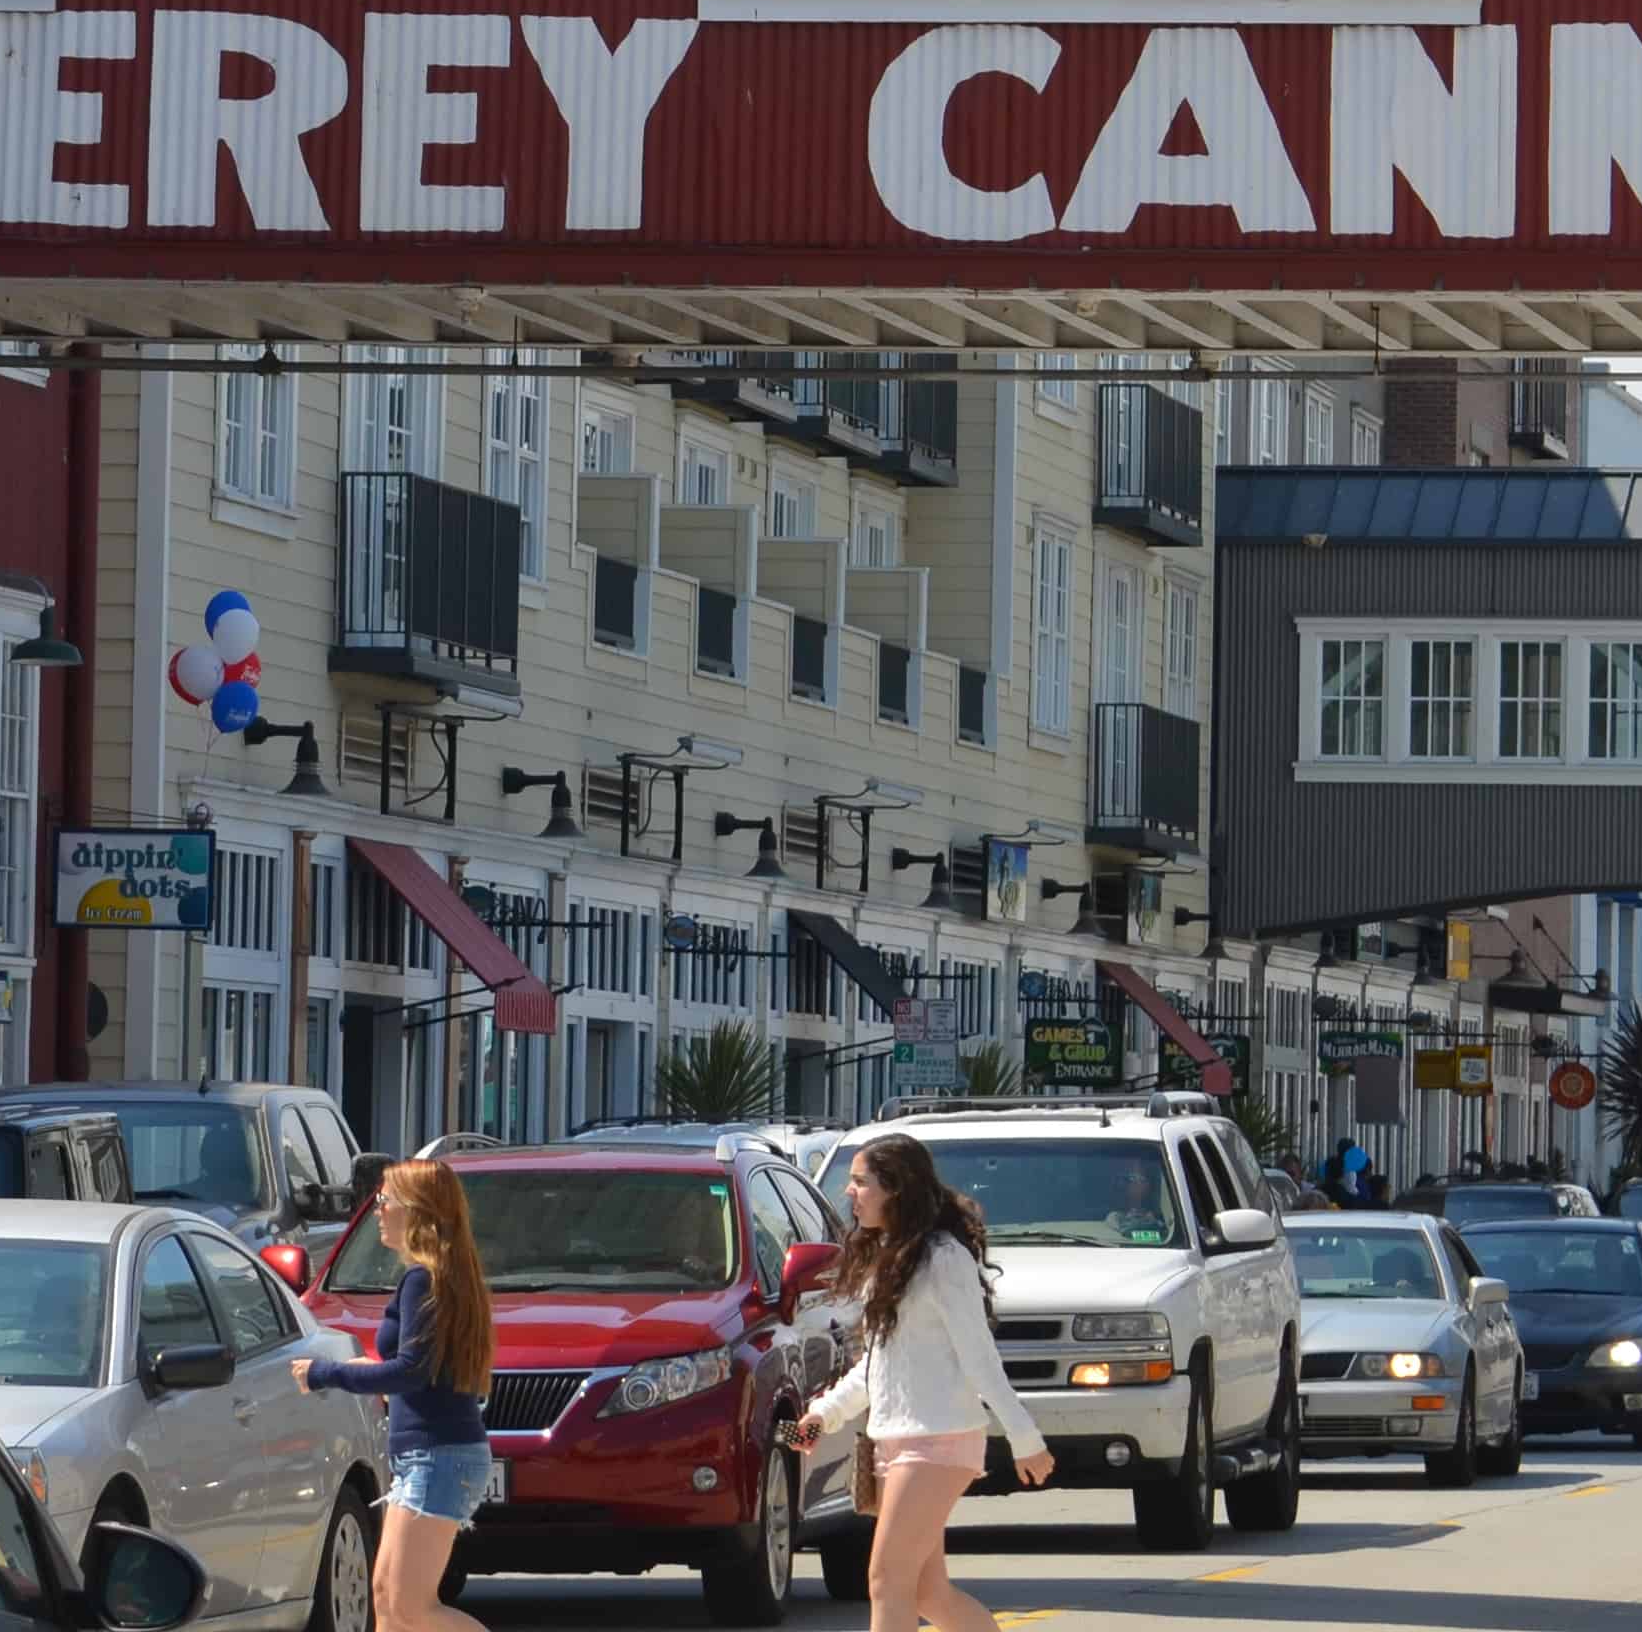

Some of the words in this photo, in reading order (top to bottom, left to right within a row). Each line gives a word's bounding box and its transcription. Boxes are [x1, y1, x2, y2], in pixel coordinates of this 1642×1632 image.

[1032, 1027, 1086, 1043] GAMES
[901, 1045, 910, 1061] 2
[1064, 1044, 1107, 1062] GRUB
